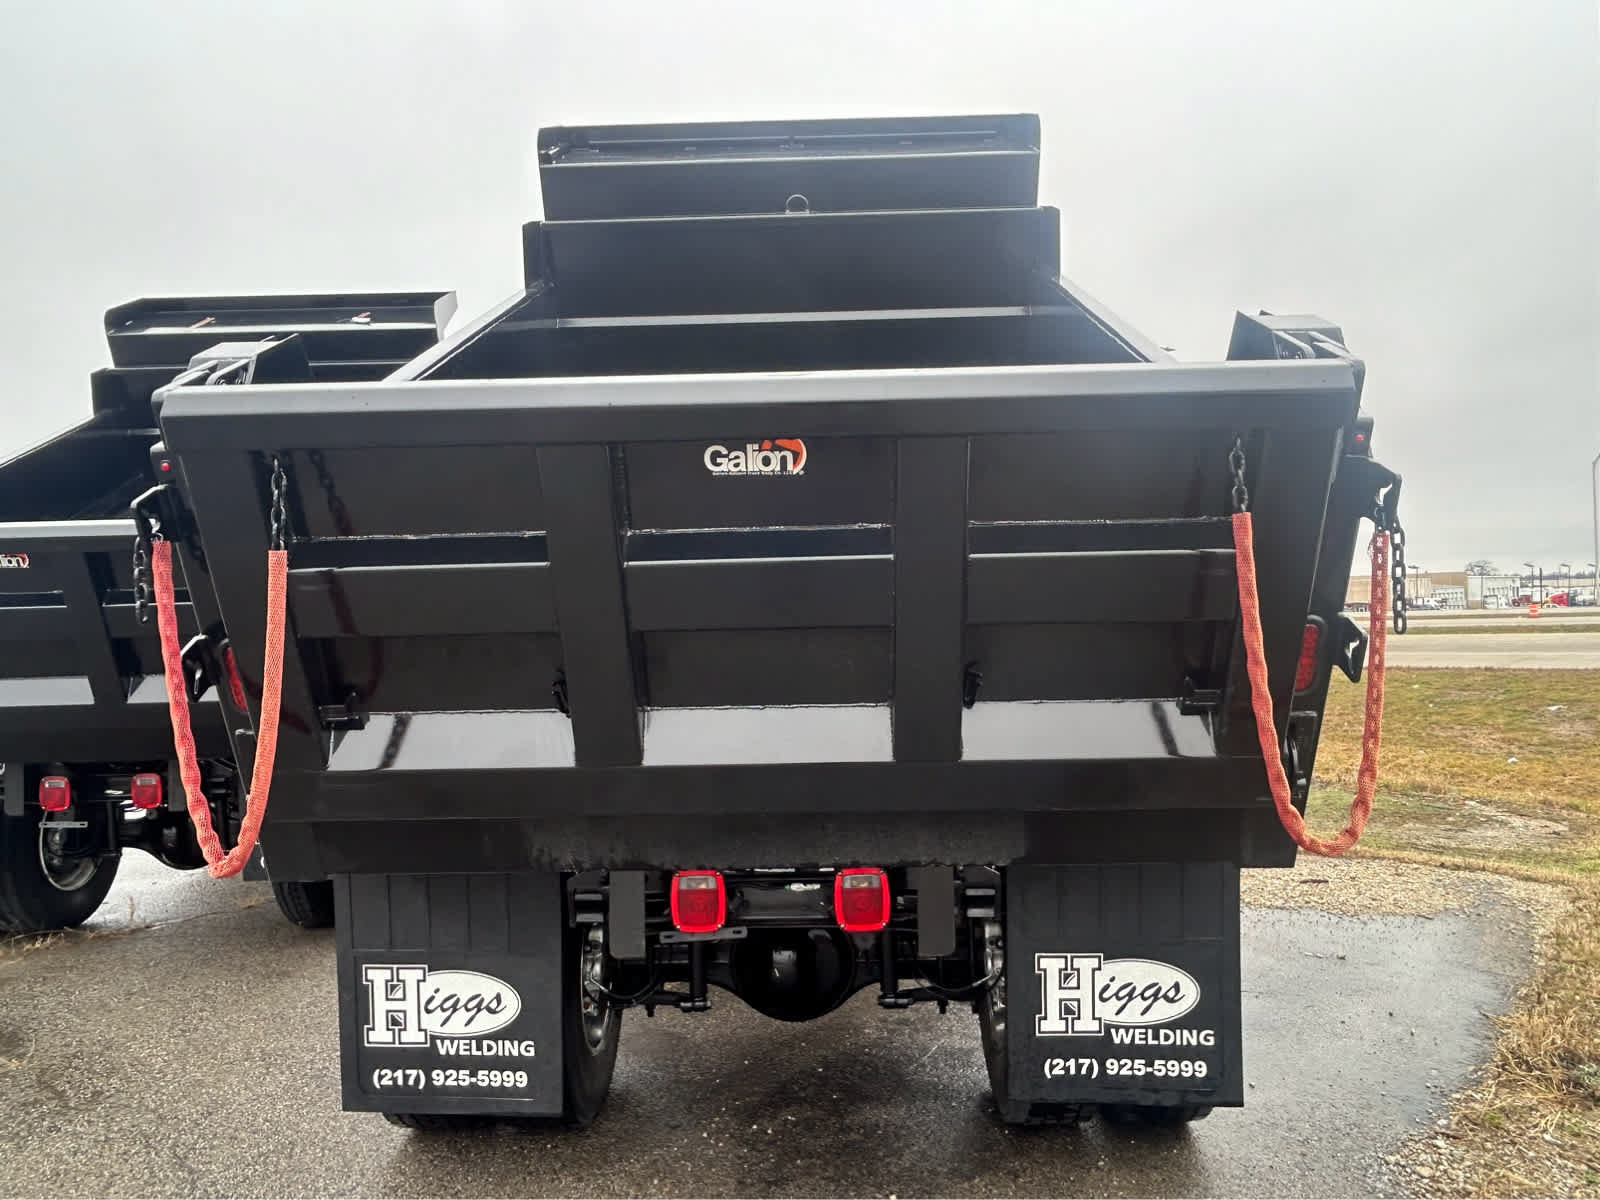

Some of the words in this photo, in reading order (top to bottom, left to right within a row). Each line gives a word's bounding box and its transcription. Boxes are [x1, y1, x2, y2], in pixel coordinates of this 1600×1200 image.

[703, 443, 795, 473] Galion
[1035, 953, 1188, 1036] Higgs
[362, 964, 510, 1047] Higgs
[1110, 1028, 1216, 1046] WELDING
[436, 1039, 536, 1057] WELDING
[372, 1068, 426, 1089] (217)
[431, 1069, 529, 1088] 925-5999
[1043, 1058, 1099, 1079] (217)
[1105, 1058, 1208, 1078] 925-5999
